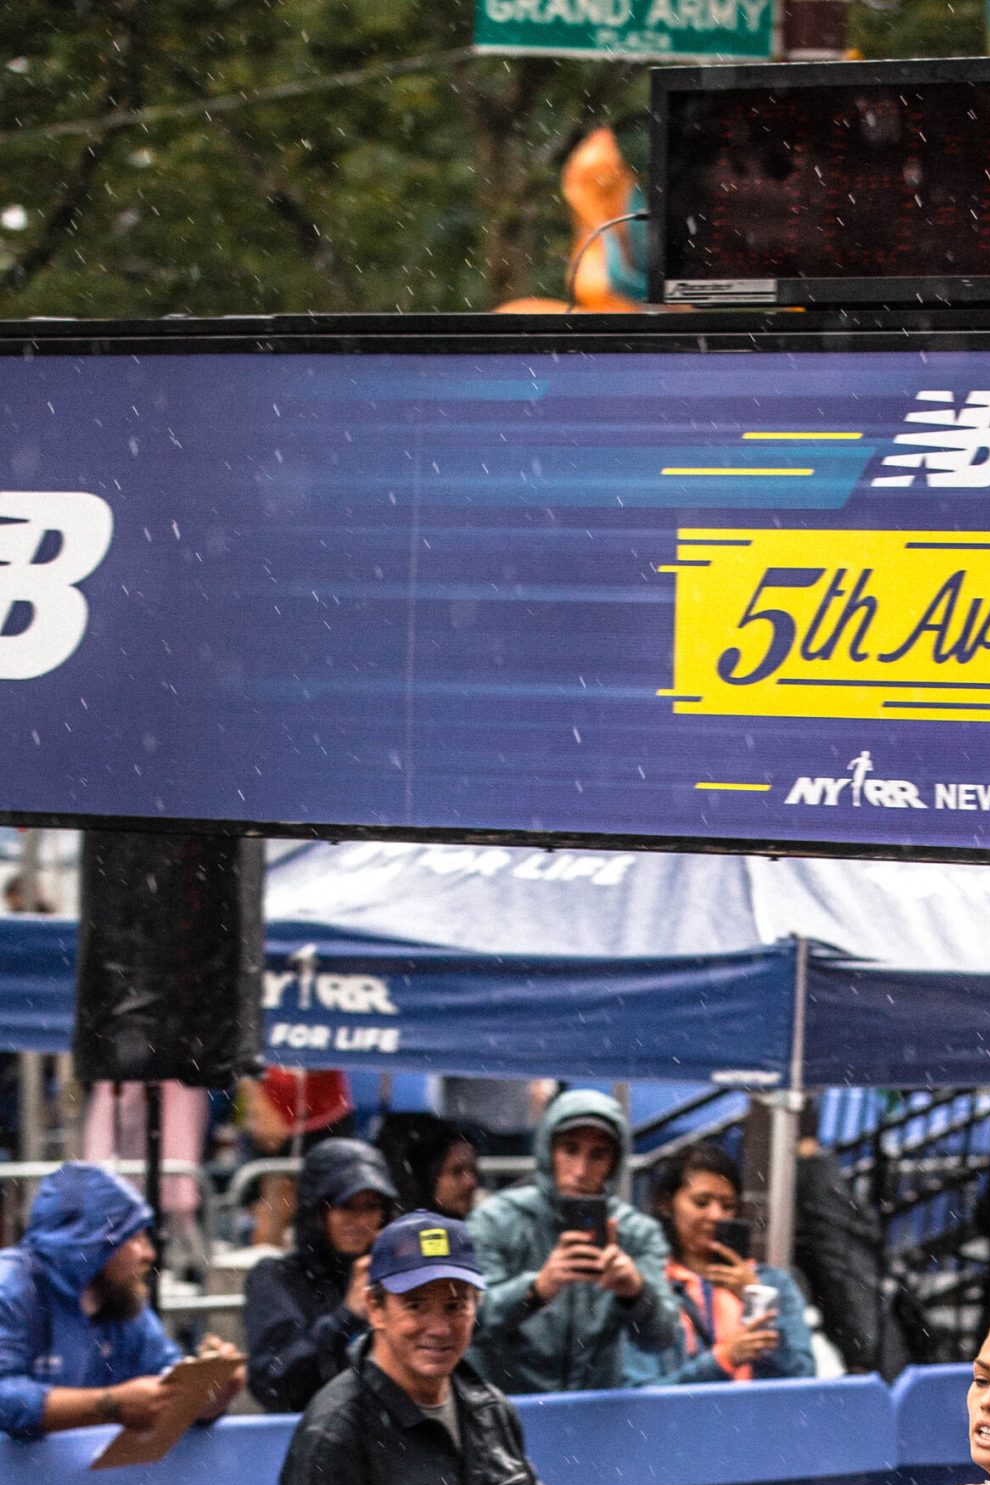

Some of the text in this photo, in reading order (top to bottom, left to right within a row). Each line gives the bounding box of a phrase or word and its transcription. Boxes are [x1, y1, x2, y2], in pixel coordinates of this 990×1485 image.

[713, 566, 879, 686] 5th
[270, 1022, 400, 1053] FOR LIFE
